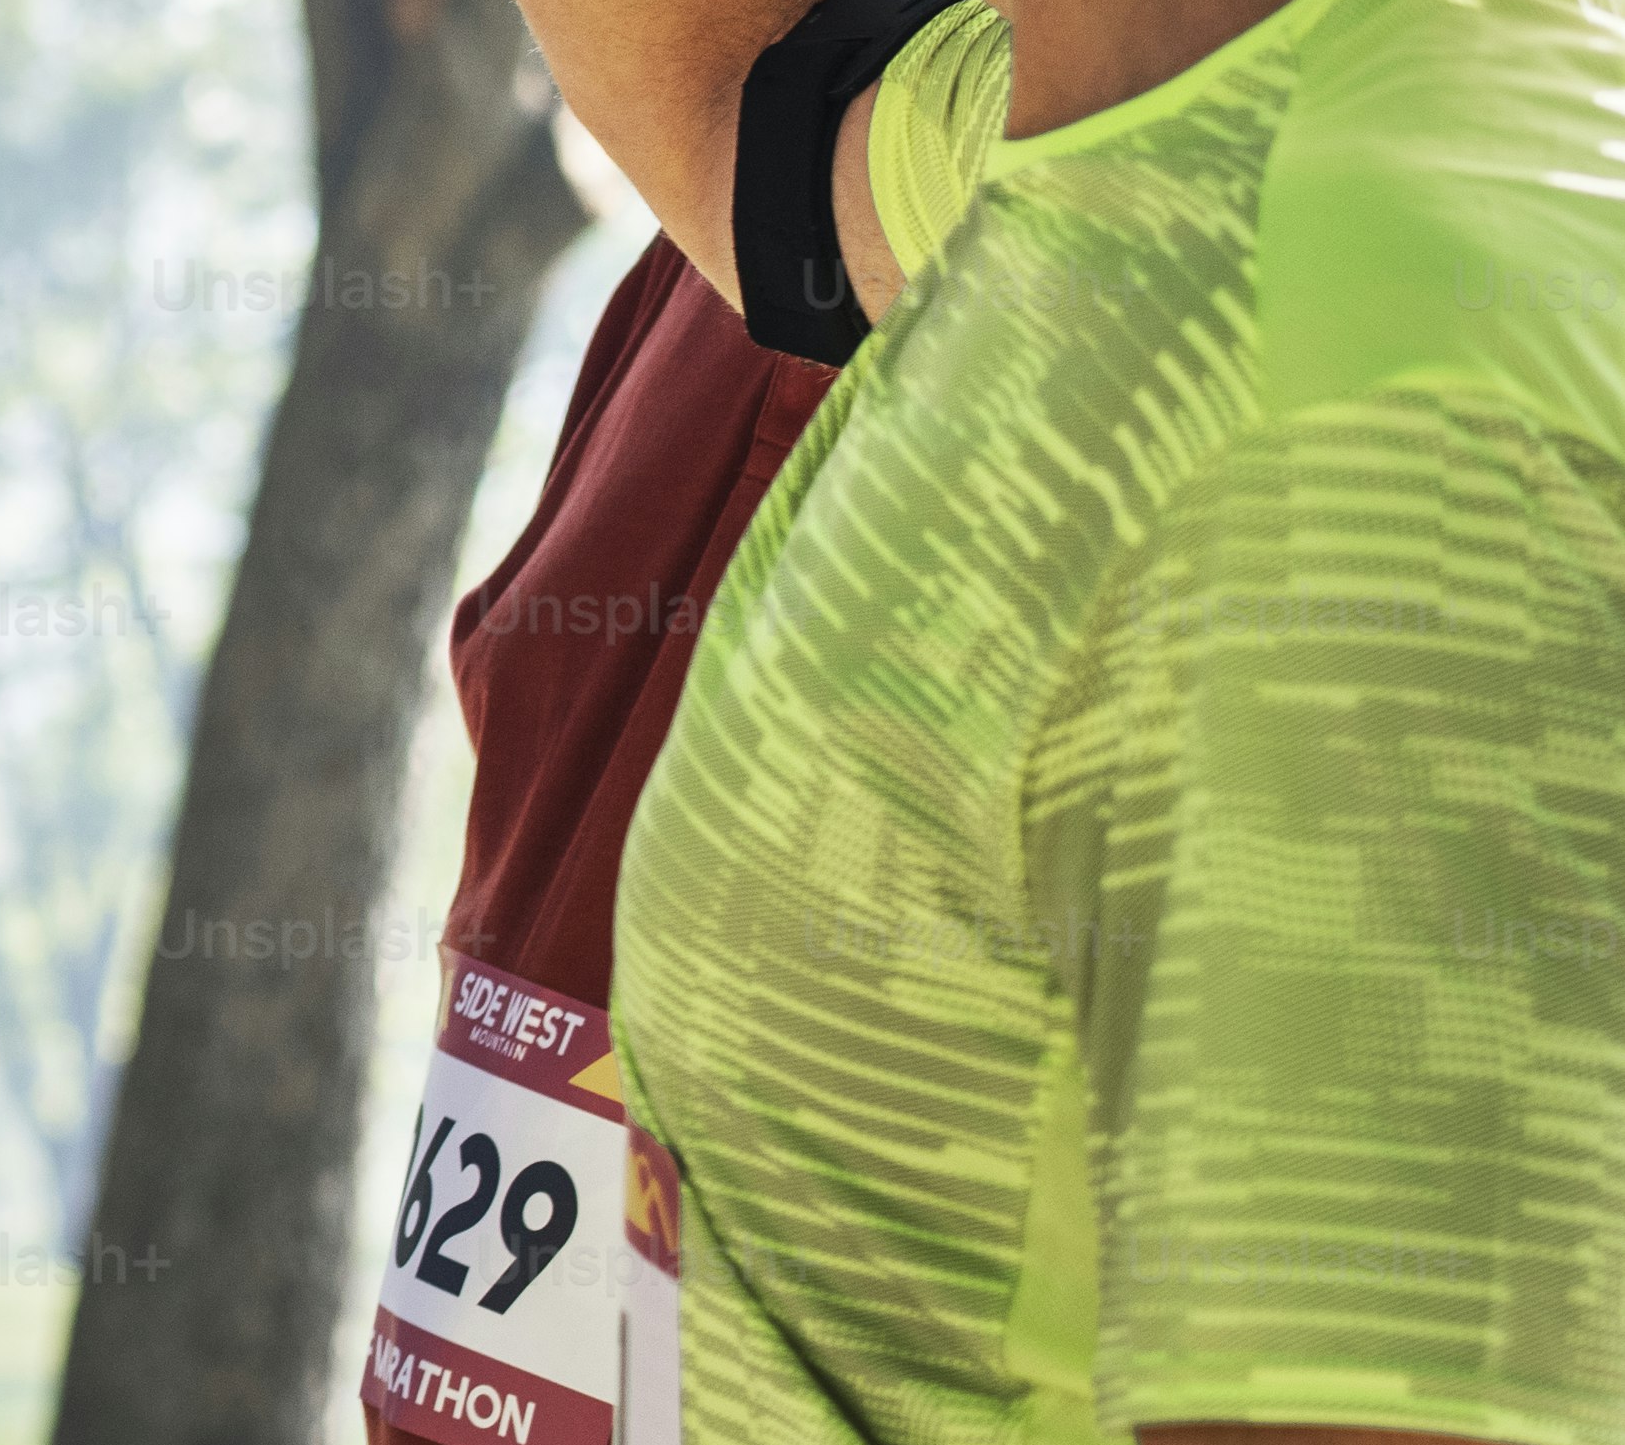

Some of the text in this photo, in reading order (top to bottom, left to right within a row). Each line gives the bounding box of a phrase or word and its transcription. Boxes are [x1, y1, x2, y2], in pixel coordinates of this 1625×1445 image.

[454, 972, 585, 1056] SIDE WEST
[469, 1026, 527, 1061] MOUNTAIN
[395, 1103, 578, 1315] 629
